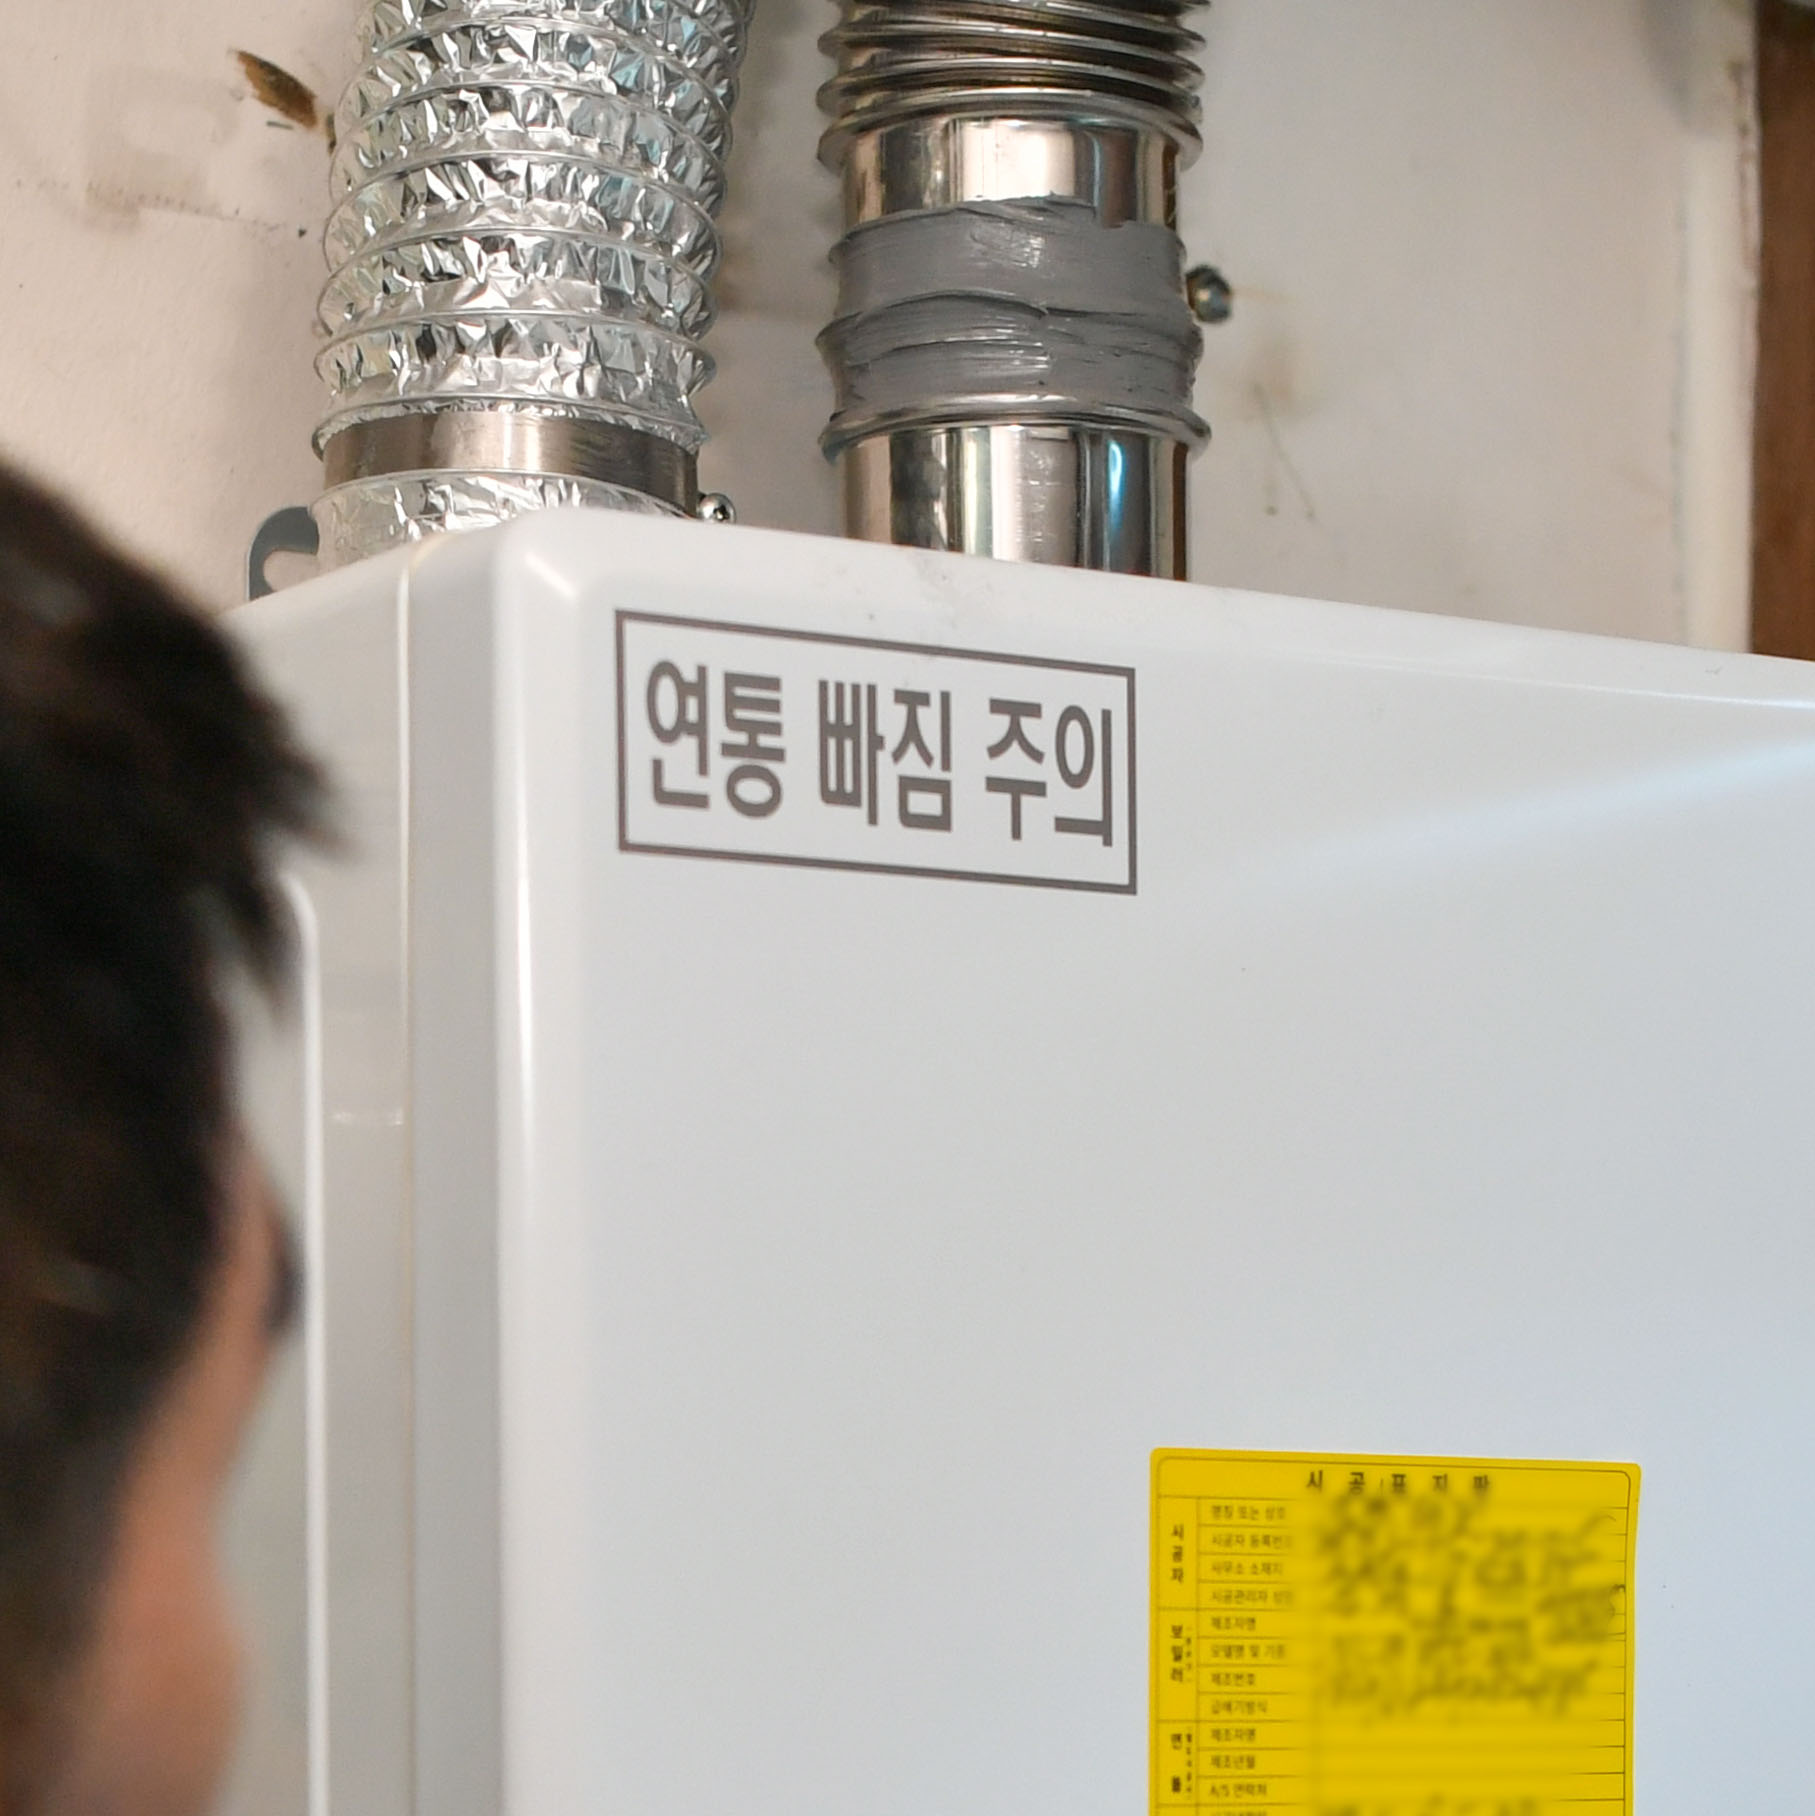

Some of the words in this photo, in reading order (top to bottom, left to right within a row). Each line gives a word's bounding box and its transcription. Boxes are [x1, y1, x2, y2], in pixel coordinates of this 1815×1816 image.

[647, 660, 786, 819] 연통
[818, 678, 952, 833] 빠짐
[985, 696, 1114, 848] 주의
